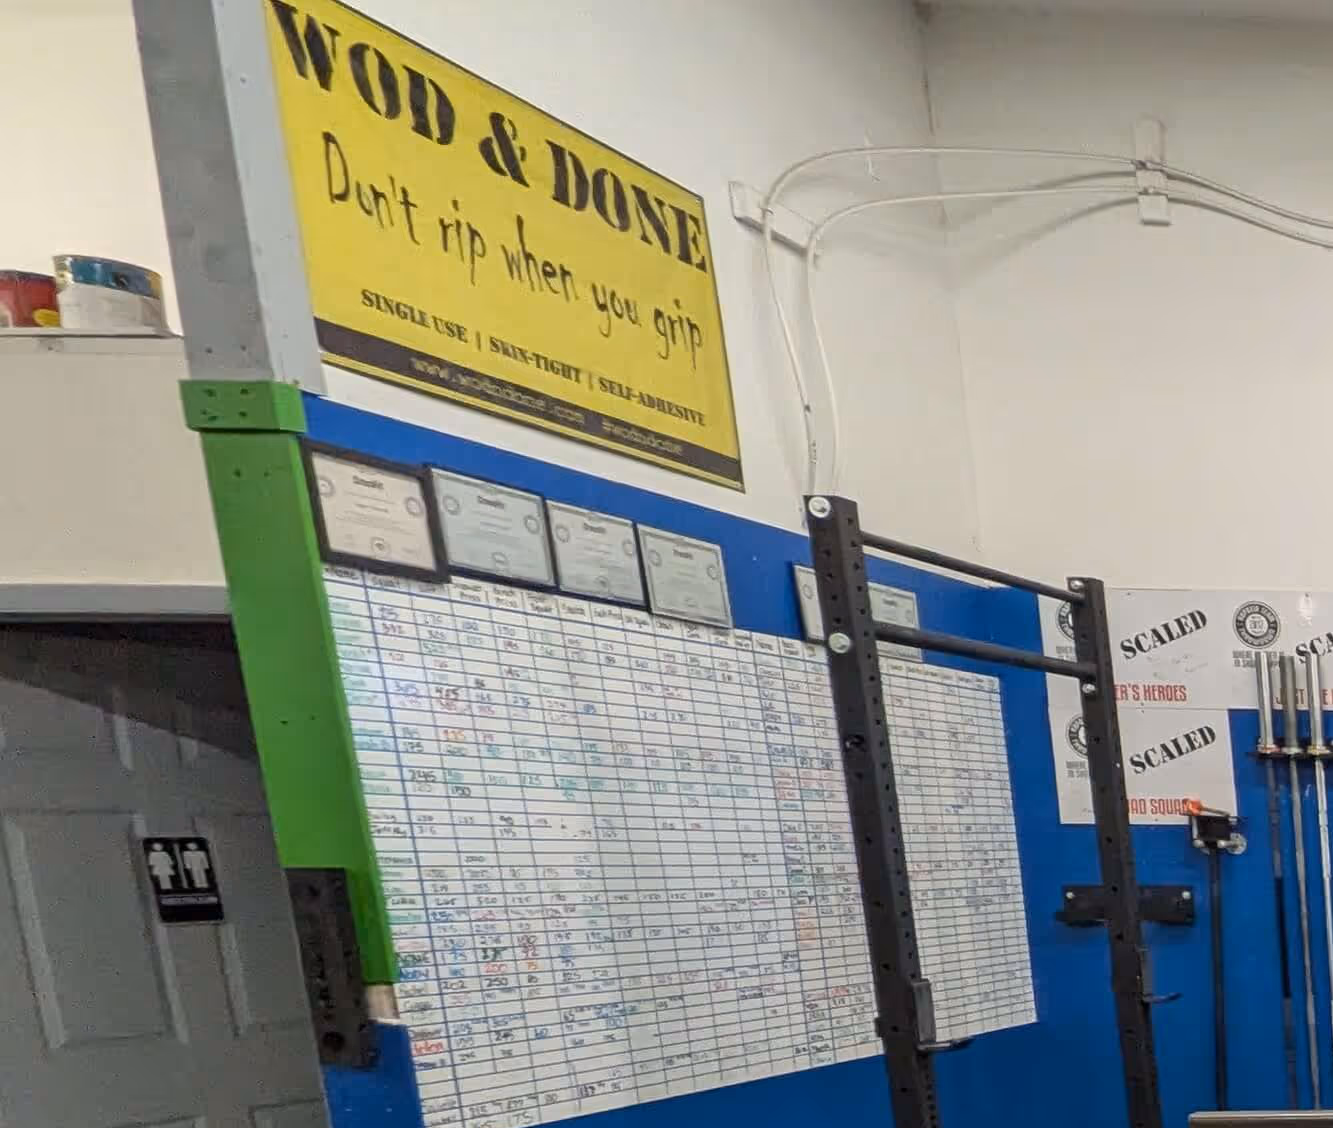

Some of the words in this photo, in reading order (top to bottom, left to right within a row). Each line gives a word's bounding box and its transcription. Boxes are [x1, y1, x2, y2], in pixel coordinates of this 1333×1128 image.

[270, 0, 456, 146] WOD
[479, 111, 530, 188] &
[546, 138, 708, 273] DONE
[322, 131, 420, 245] Don't
[439, 200, 486, 285] rip
[501, 215, 580, 302] when
[591, 283, 643, 337] you
[653, 300, 704, 370] grip
[360, 288, 430, 330] SINGLE
[433, 315, 468, 344] USE
[489, 335, 582, 385] SKIN-TIGHT
[598, 378, 707, 428] SELF-ADHESIVE
[1120, 609, 1208, 660] SCALED
[1144, 684, 1187, 701] HEROES
[1129, 725, 1216, 774] SCALED
